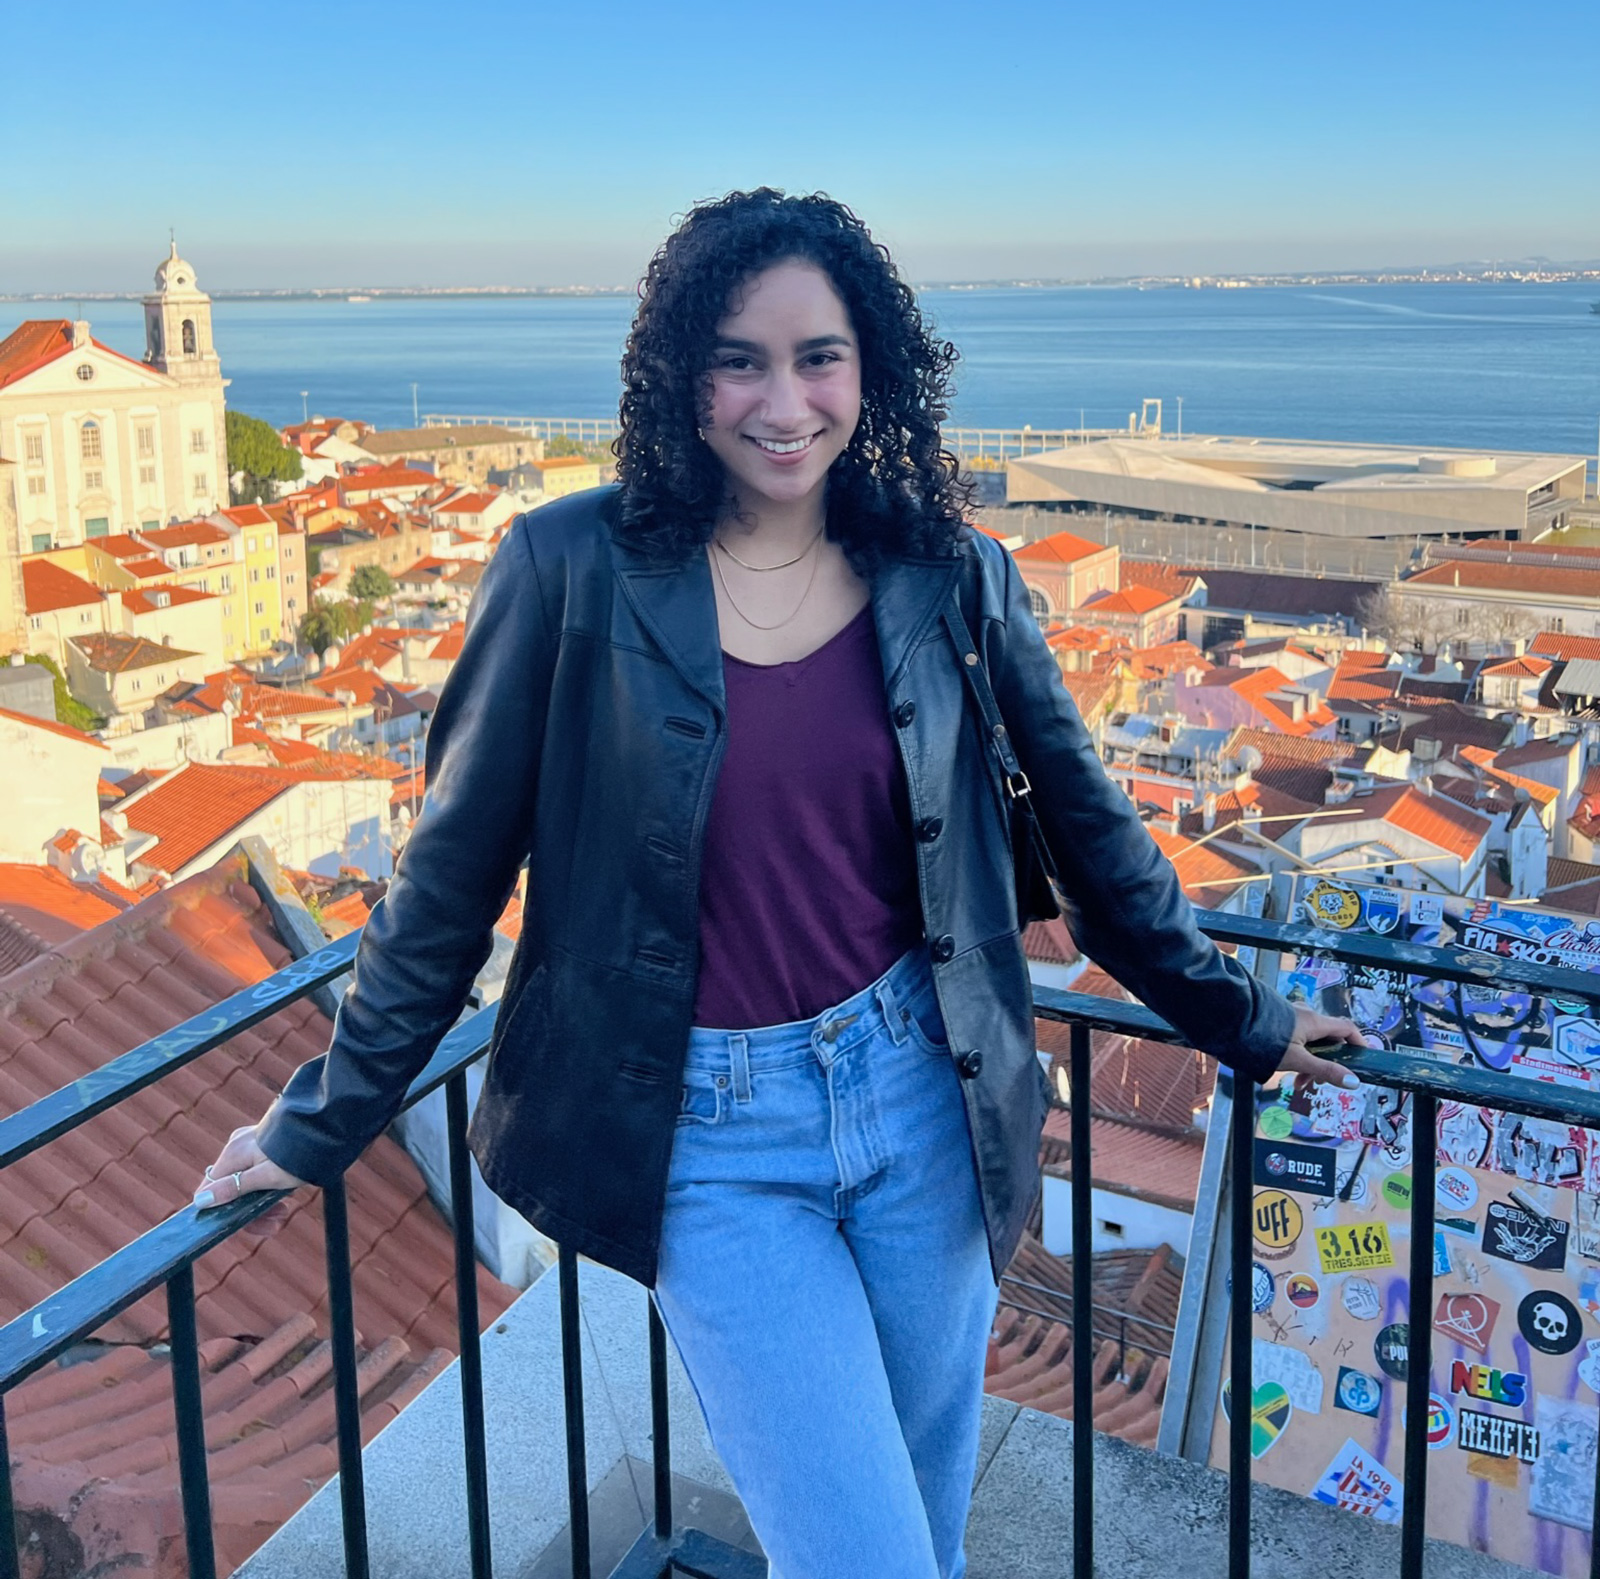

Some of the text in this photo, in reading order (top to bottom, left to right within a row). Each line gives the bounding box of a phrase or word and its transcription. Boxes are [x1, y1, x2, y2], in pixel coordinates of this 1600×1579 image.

[1520, 1057, 1583, 1078] Stadtmeister
[1287, 1160, 1323, 1177] RUDE
[1256, 1198, 1290, 1241] UFF
[1321, 1226, 1382, 1258] 3.16
[1324, 1254, 1391, 1269] TRES.SETZE
[1351, 1455, 1392, 1495] LA 1918
